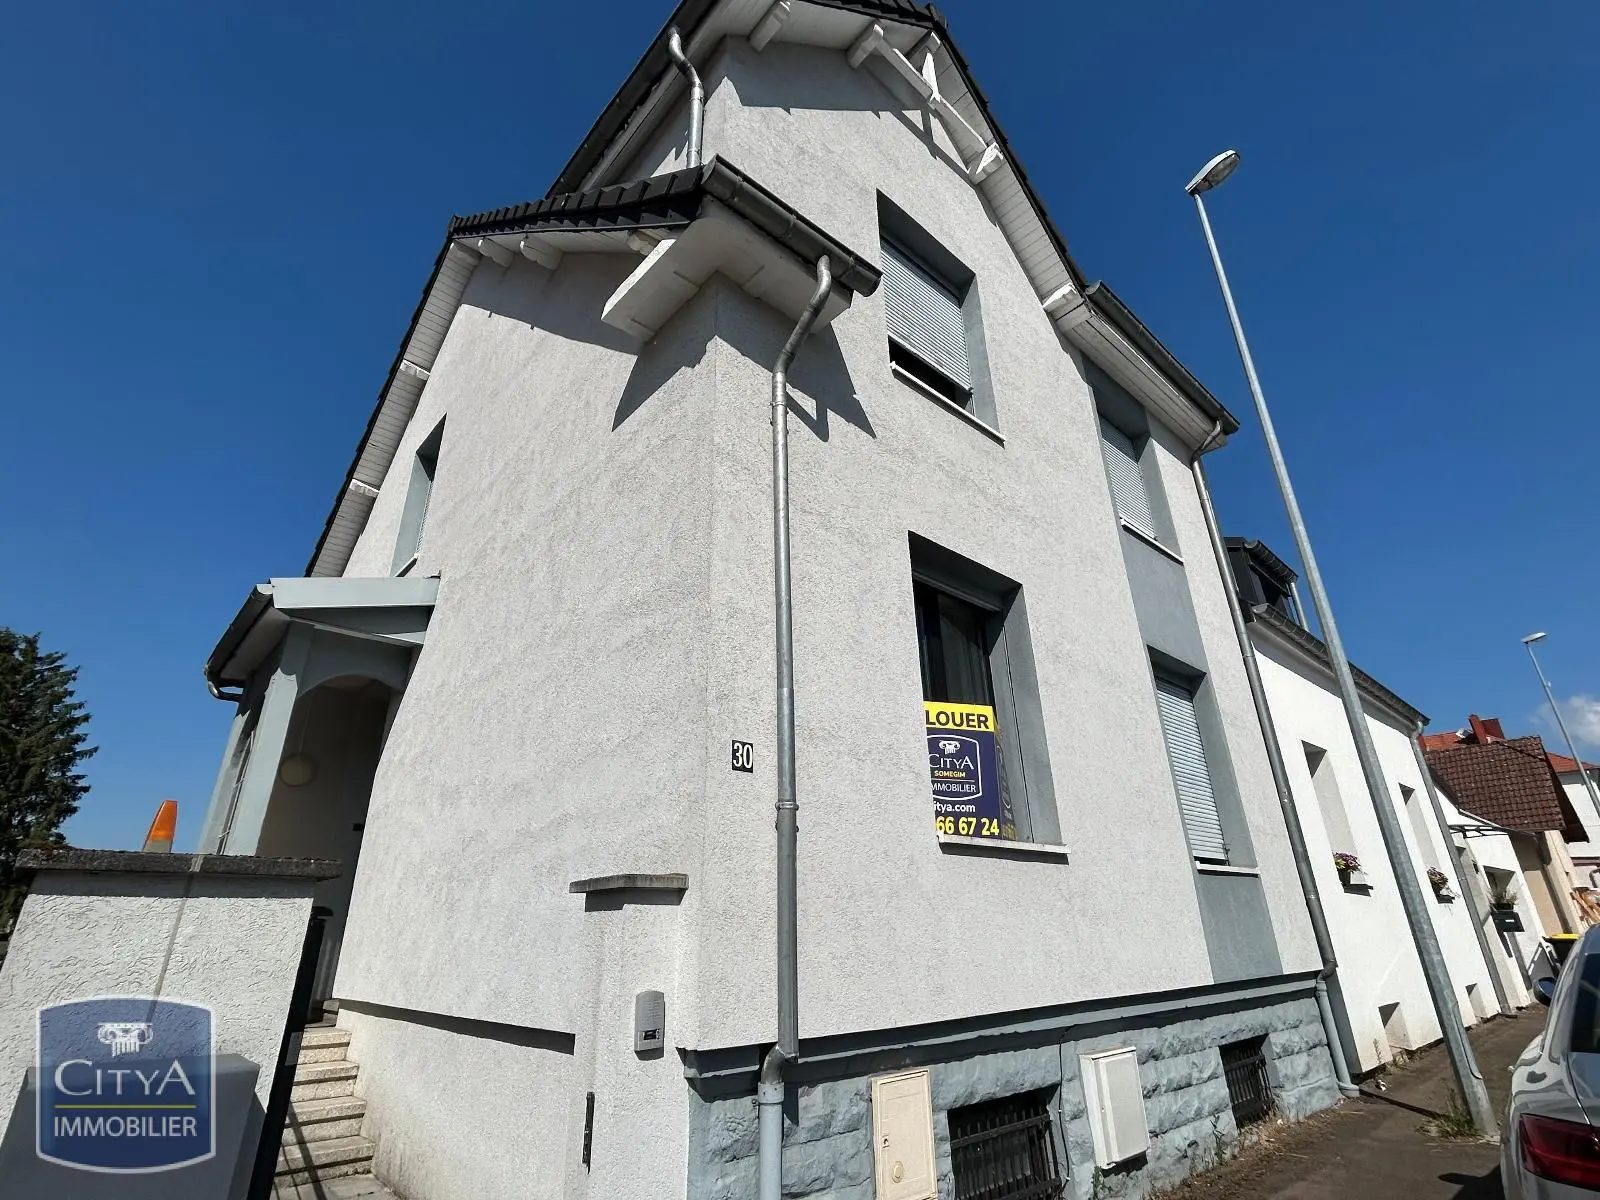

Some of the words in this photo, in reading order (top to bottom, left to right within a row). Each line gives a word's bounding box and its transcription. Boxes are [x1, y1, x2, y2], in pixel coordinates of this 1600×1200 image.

[733, 742, 753, 769] 30
[931, 782, 977, 793] MMOBILIER
[933, 801, 976, 813] itya.com
[936, 816, 955, 835] 66
[958, 816, 977, 835] 67
[981, 817, 1000, 836] 24
